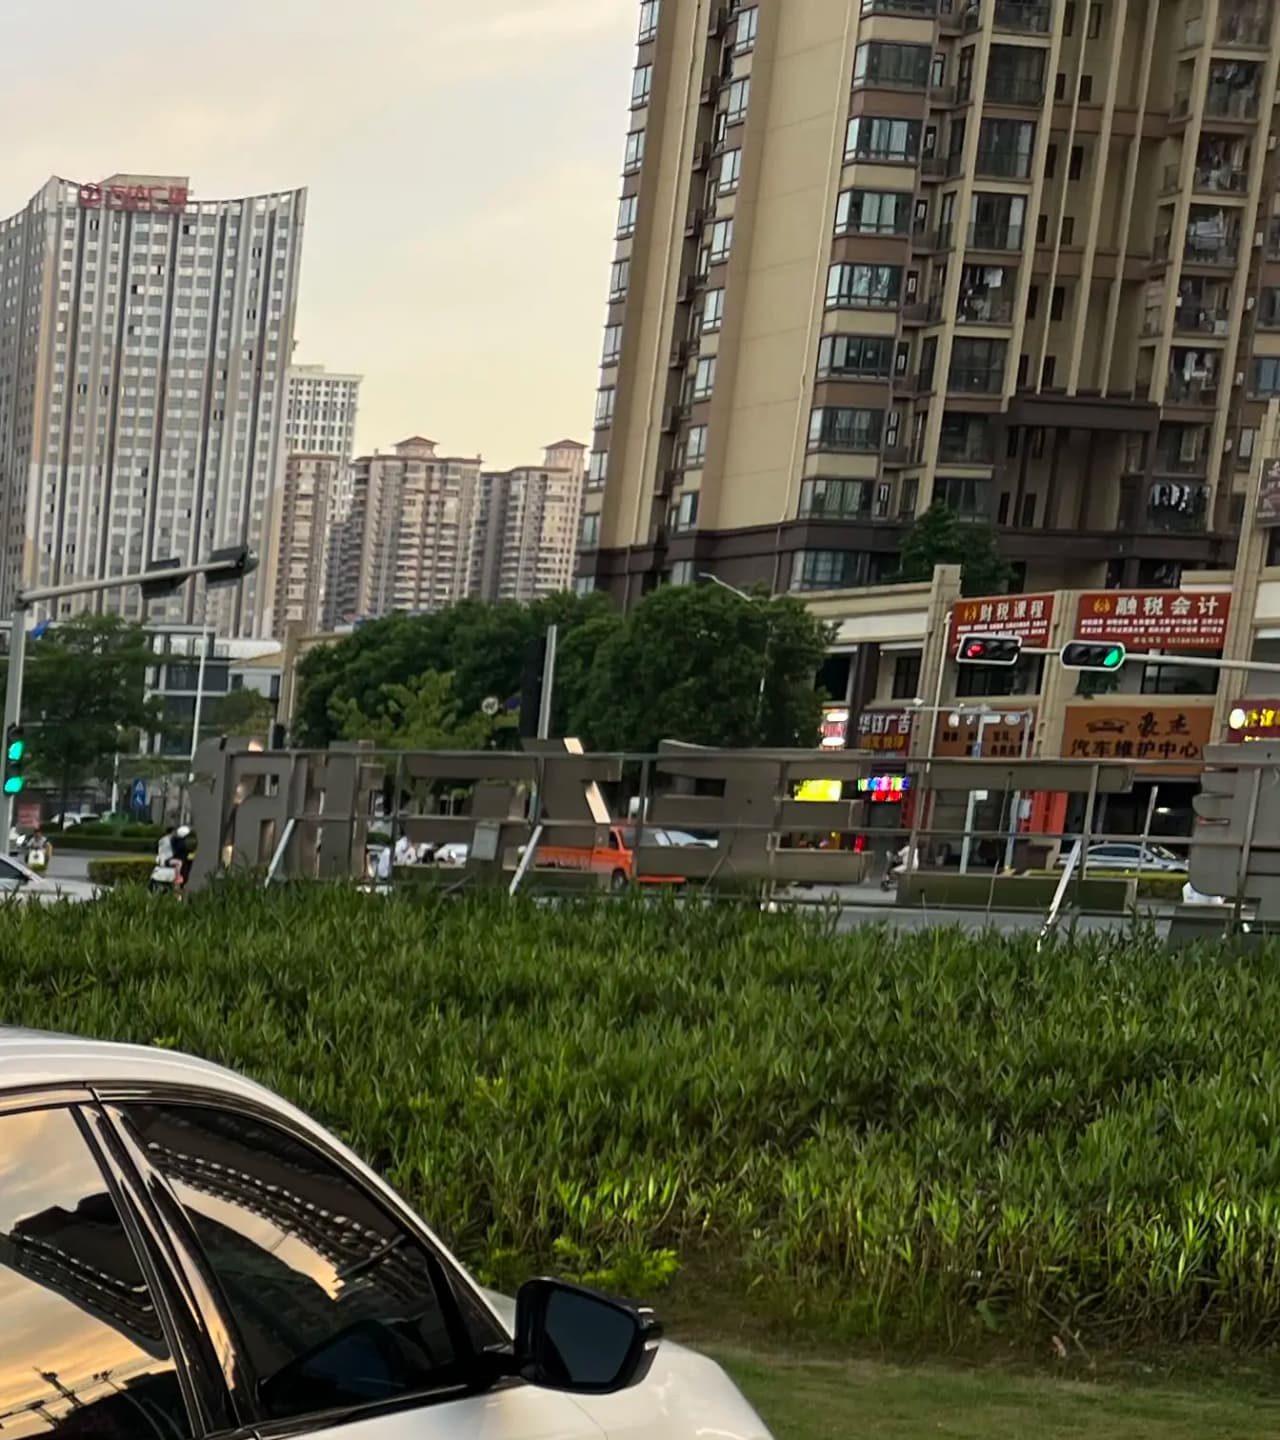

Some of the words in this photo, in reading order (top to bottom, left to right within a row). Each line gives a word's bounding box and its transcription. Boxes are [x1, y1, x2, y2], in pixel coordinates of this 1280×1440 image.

[1115, 595, 1219, 616] 融税会计
[1071, 738, 1199, 758] 汽车维护中心
